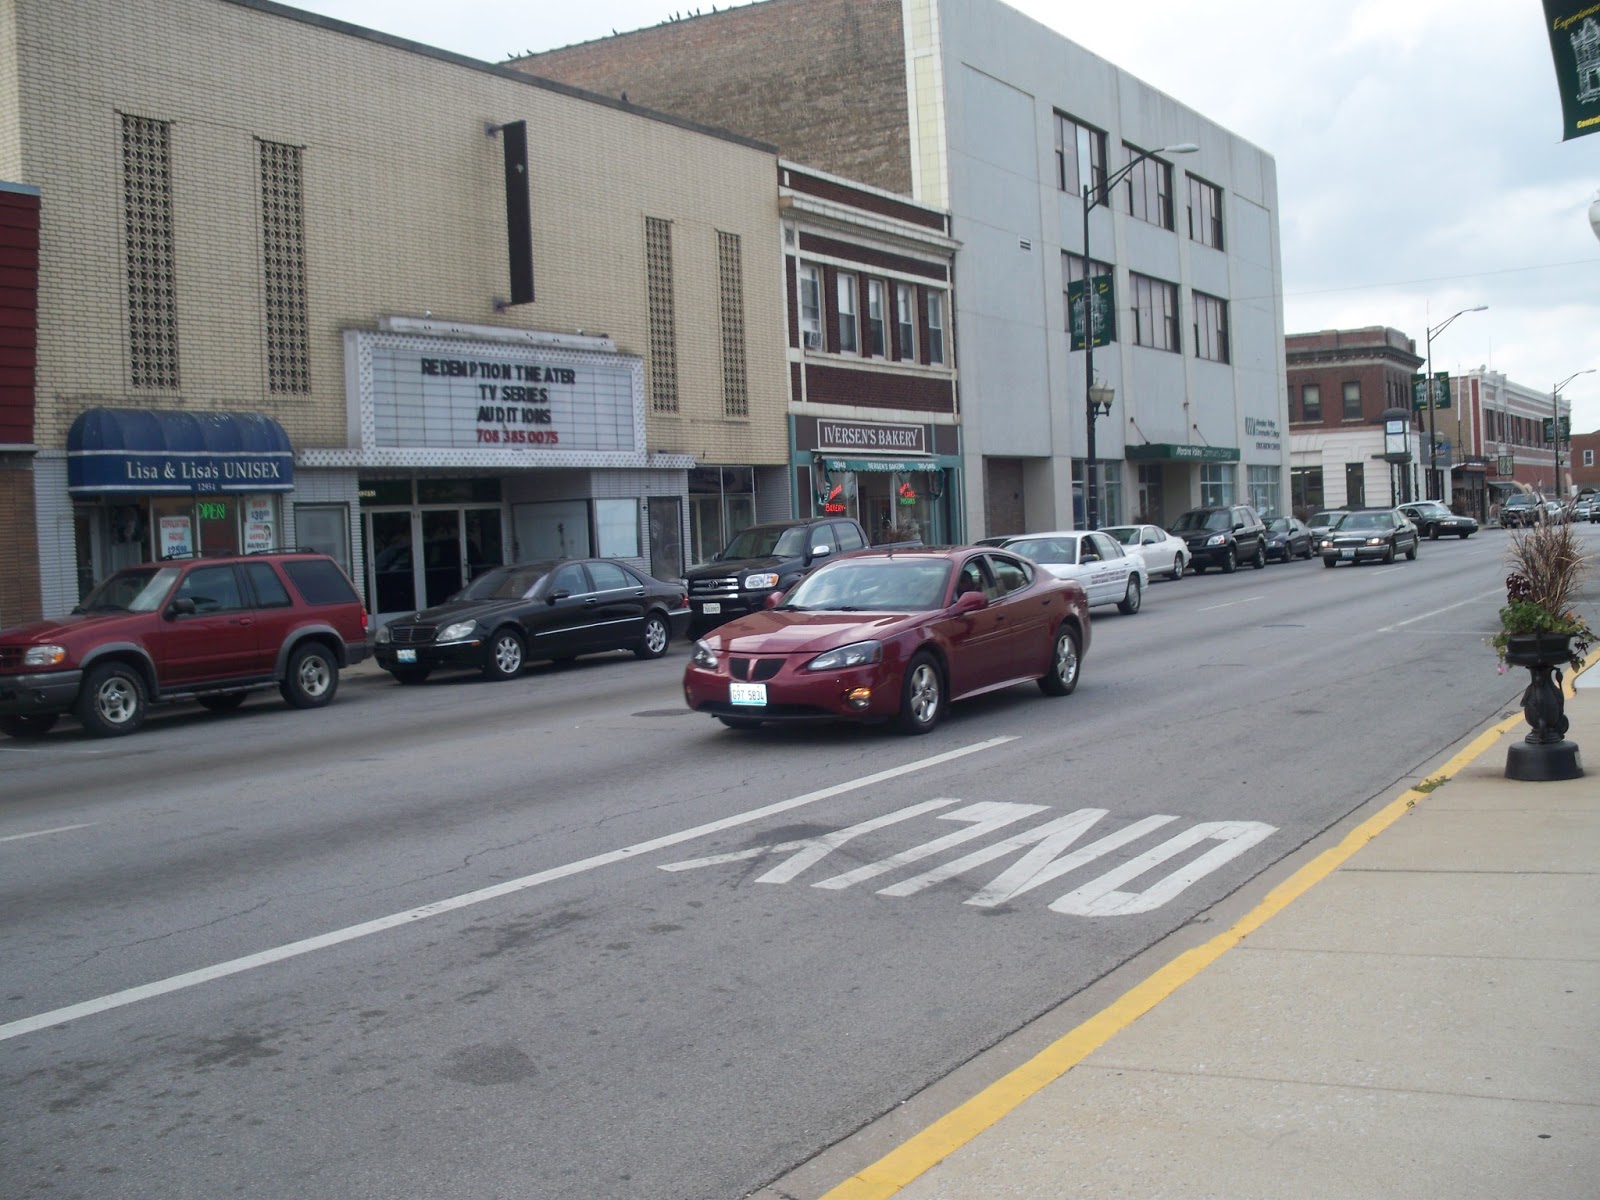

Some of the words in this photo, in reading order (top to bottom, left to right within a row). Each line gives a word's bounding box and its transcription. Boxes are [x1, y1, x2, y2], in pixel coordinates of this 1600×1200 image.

[421, 358, 511, 381] REDEMPTION
[479, 384, 497, 401] TV
[502, 387, 548, 403] SERIES
[477, 406, 552, 424] AUDITIONS
[477, 429, 499, 443] 708
[503, 430, 526, 443] 385
[528, 430, 559, 444] 0075
[824, 425, 876, 445] IVERSEN'S
[878, 429, 918, 447] BAKERY
[126, 461, 158, 479] Lisa
[163, 462, 176, 479] &
[182, 461, 219, 479] Lisa's
[224, 462, 280, 479] UNISEX
[656, 797, 1281, 917] ONLY
